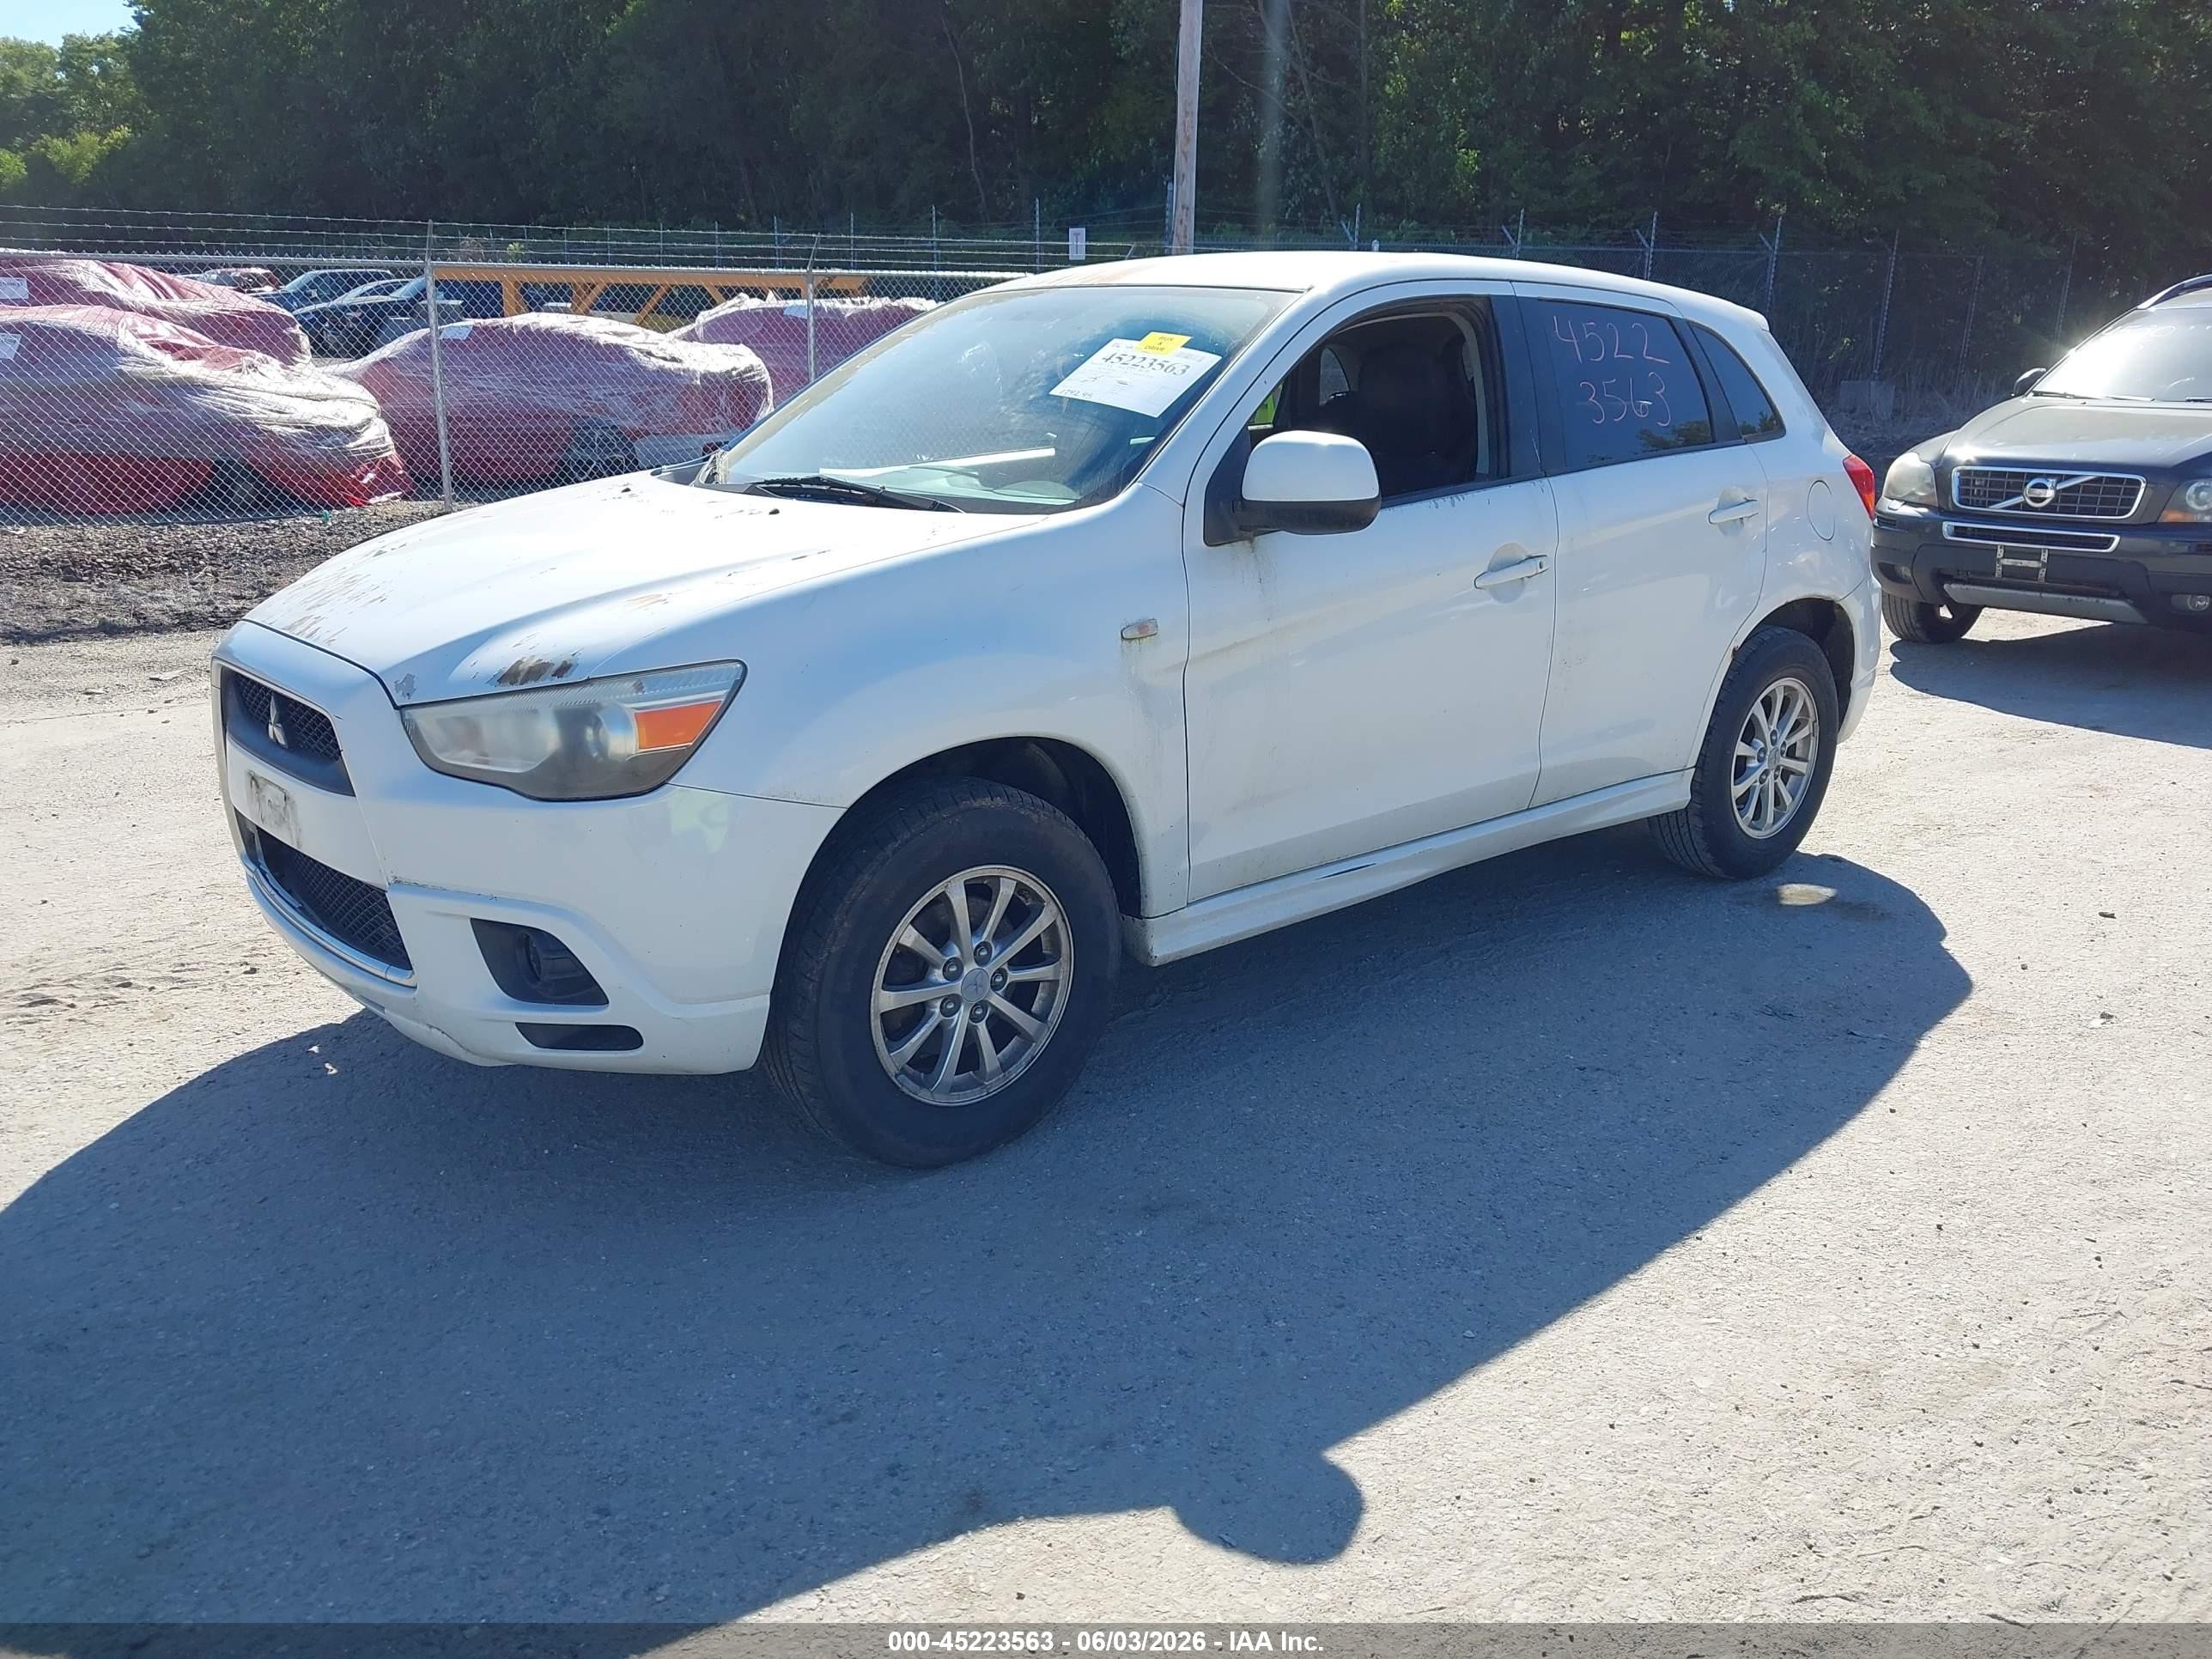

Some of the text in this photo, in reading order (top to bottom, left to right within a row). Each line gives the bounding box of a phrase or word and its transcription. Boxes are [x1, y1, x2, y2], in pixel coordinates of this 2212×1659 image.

[1144, 343, 1166, 352] DRIVE
[1553, 315, 1671, 364] 4522
[1102, 352, 1191, 376] 45223563
[1579, 371, 1672, 427] 3563
